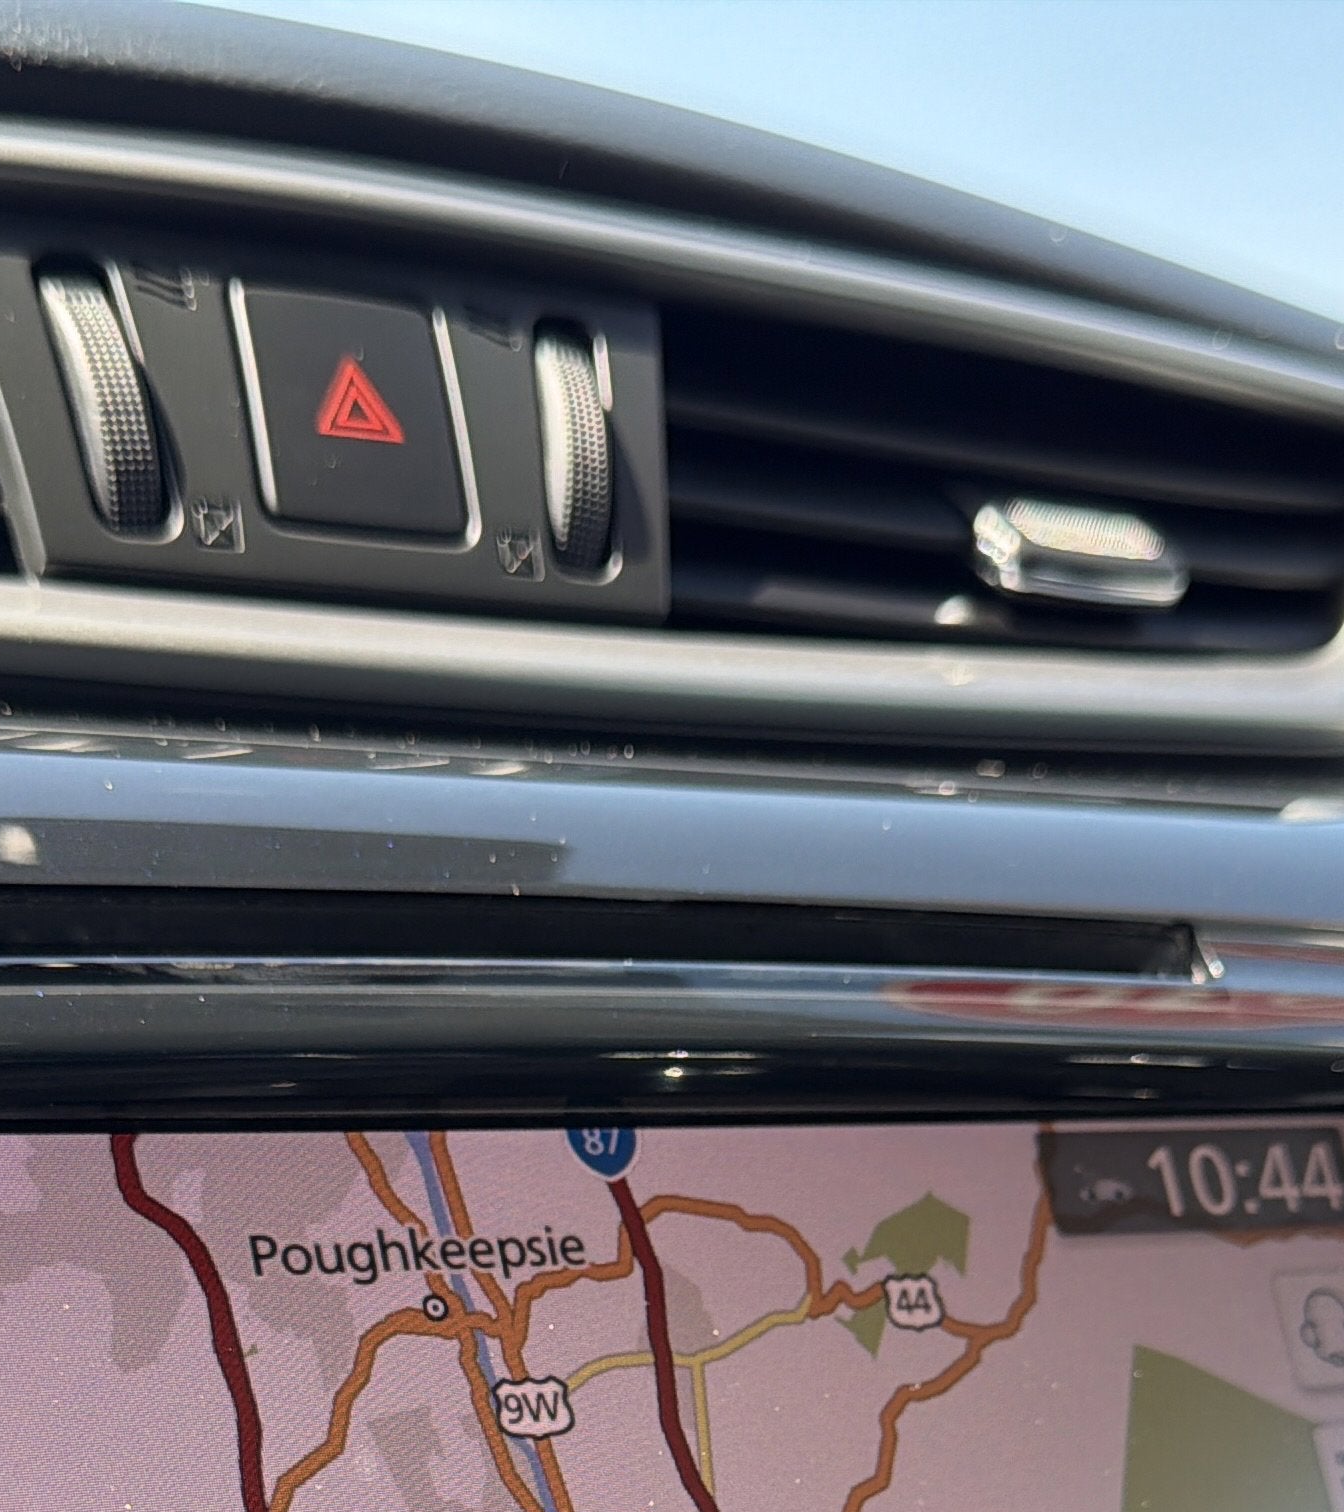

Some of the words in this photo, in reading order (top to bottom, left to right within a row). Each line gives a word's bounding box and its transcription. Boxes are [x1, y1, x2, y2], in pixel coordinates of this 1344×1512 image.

[582, 1128, 619, 1156] 87
[248, 1225, 587, 1285] Poughkeepsie
[896, 1287, 932, 1313] 44
[504, 1393, 558, 1424] 9W
